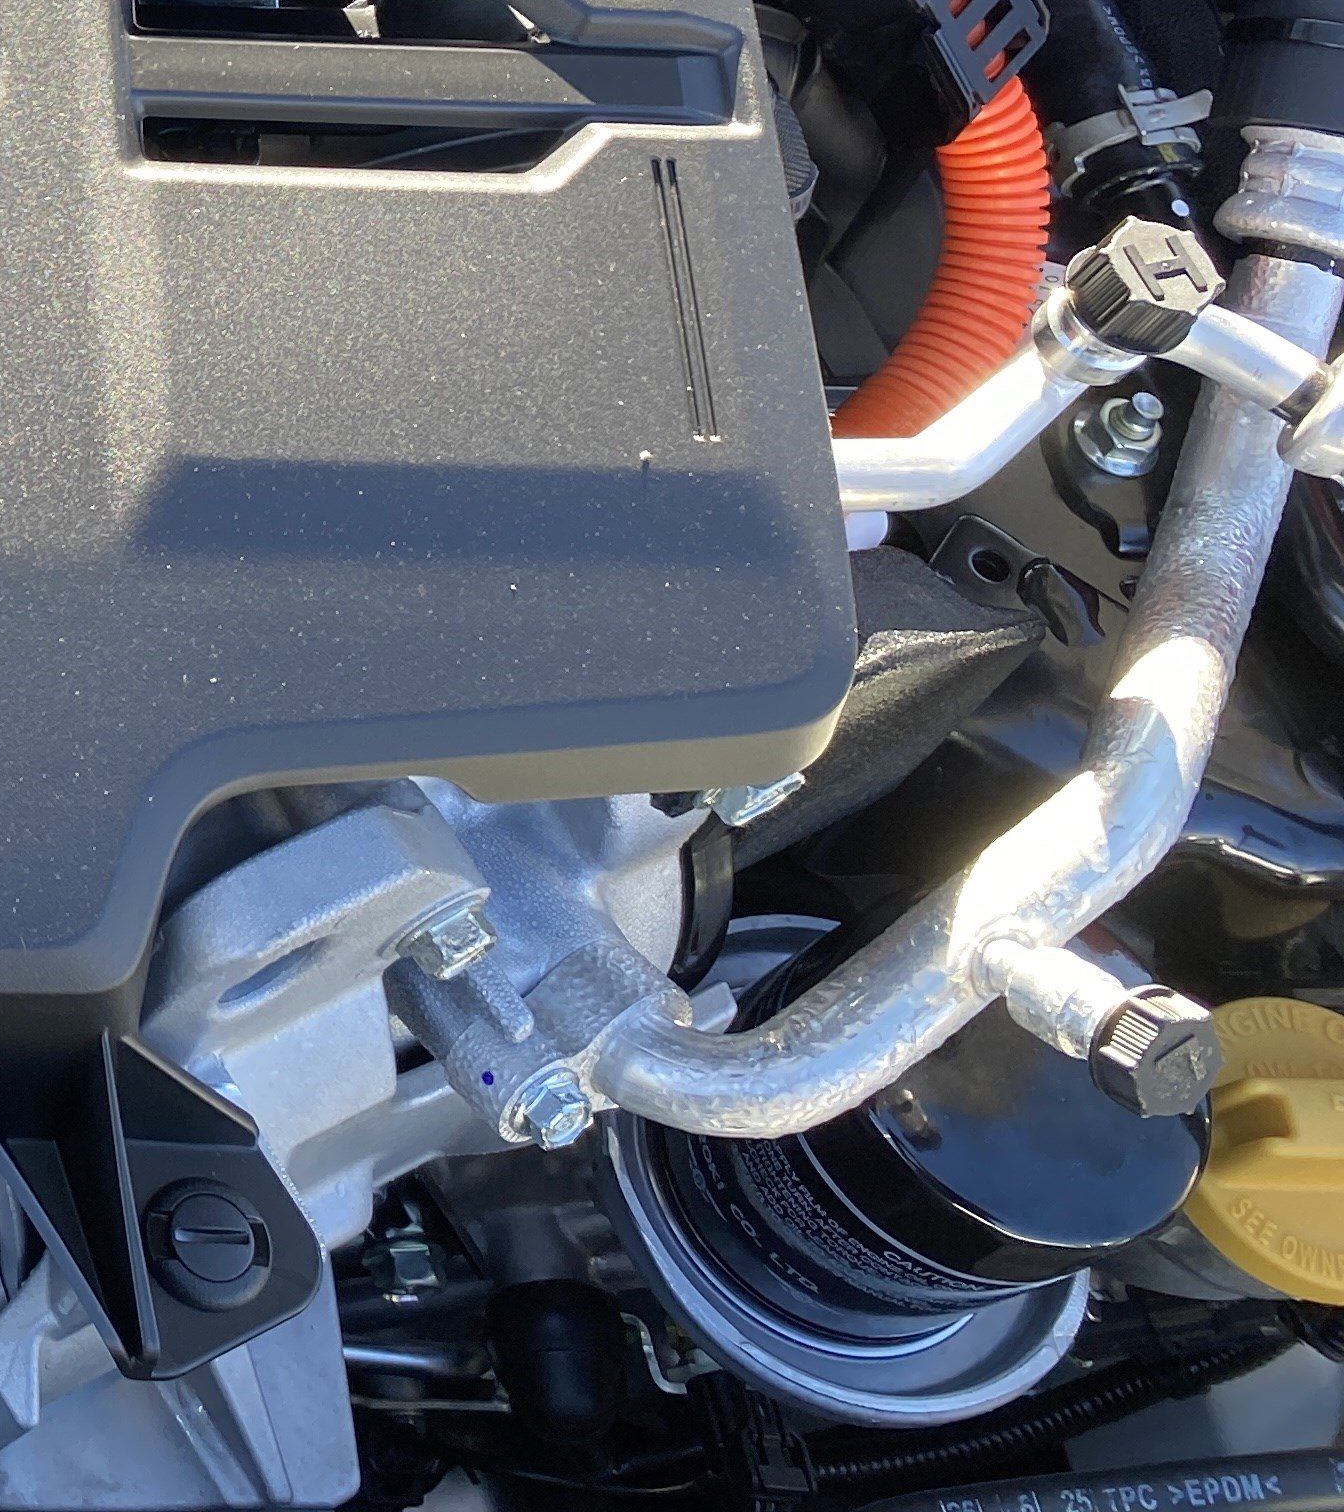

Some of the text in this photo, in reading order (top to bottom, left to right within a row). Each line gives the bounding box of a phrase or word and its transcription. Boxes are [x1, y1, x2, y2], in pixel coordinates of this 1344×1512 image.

[1122, 235, 1209, 302] H
[1231, 1198, 1279, 1247] SEE
[883, 1250, 986, 1292] CAUTION
[1102, 1483, 1158, 1511] TPC
